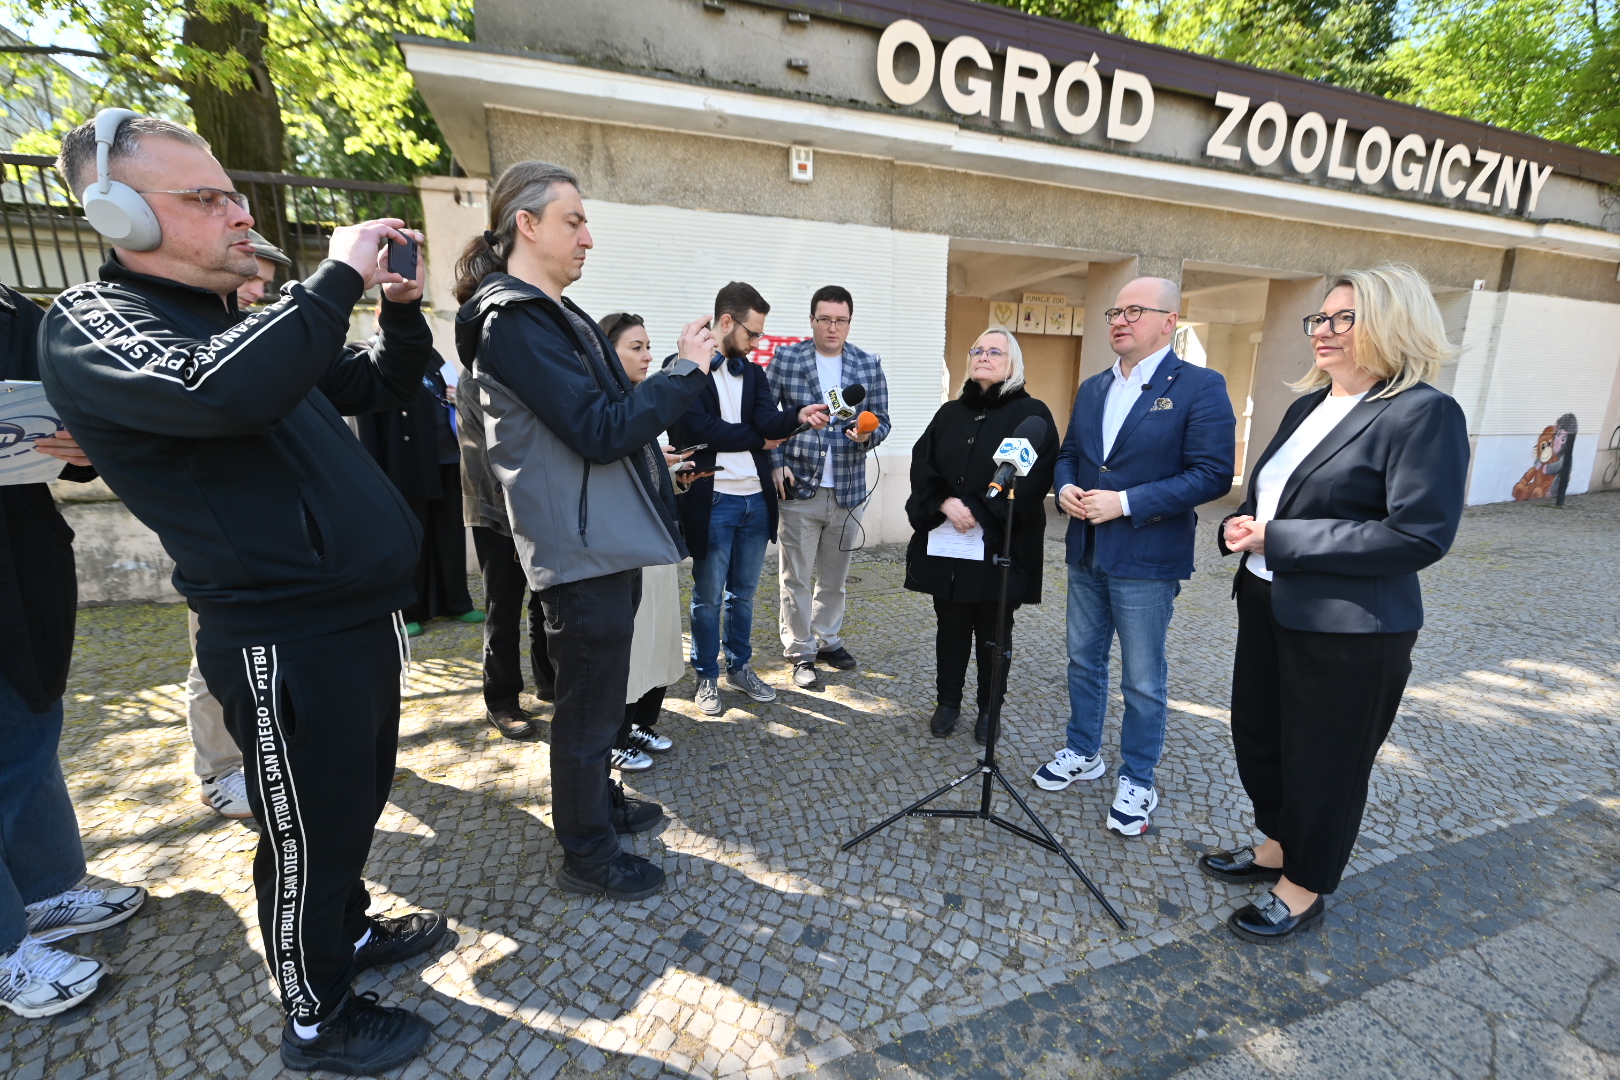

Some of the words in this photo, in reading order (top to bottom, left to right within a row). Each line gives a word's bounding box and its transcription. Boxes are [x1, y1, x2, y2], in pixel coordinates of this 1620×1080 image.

[877, 18, 1155, 144] OGRÓD
[1205, 90, 1554, 213] ZOOLOGICZNY
[1052, 296, 1065, 304] ZOO
[222, 316, 259, 343] SAN
[251, 646, 268, 690] PITBU
[257, 706, 276, 752] DIEGO
[263, 754, 283, 782] SAN
[269, 782, 293, 832] PITBULL
[282, 838, 298, 874] DIEGO
[283, 874, 298, 899] SAN
[281, 900, 296, 951] PITBULL
[281, 960, 301, 998] DIEGO
